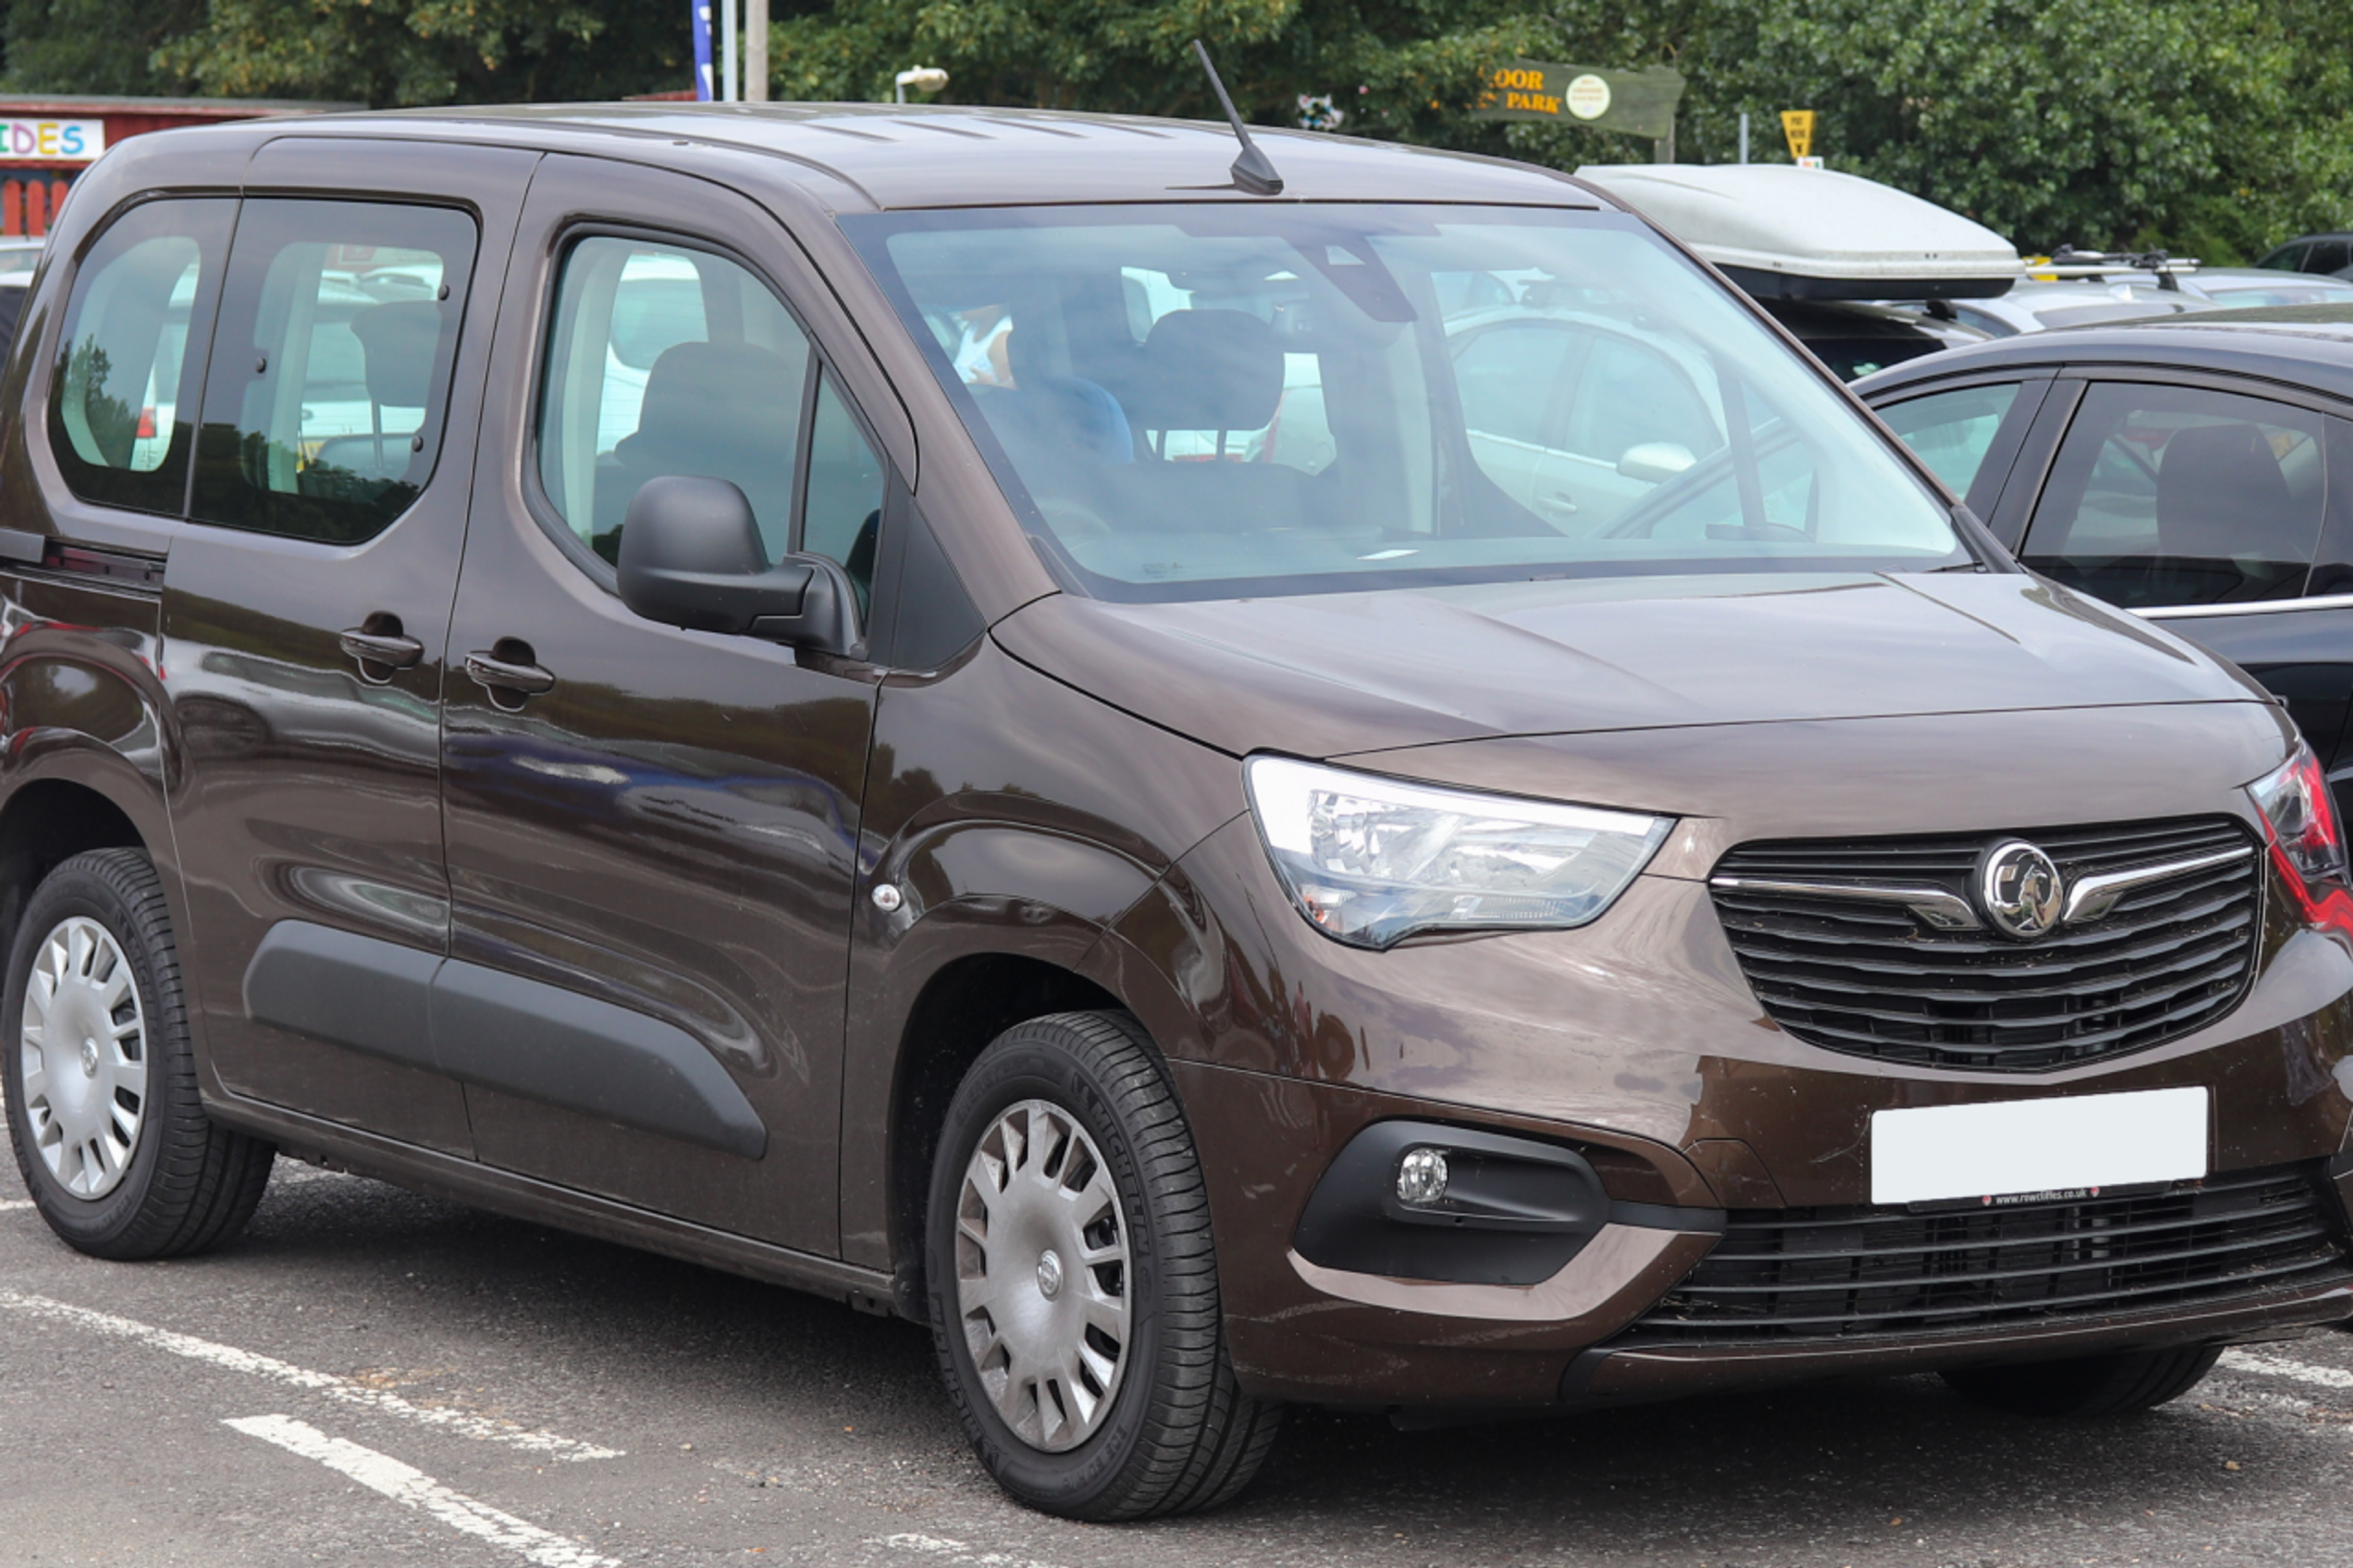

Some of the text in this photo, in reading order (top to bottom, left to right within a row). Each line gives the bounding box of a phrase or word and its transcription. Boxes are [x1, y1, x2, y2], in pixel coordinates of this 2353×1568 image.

[1477, 67, 1544, 90] OOR
[1507, 92, 1561, 115] PARK
[1091, 1100, 1151, 1255] MICHELIN
